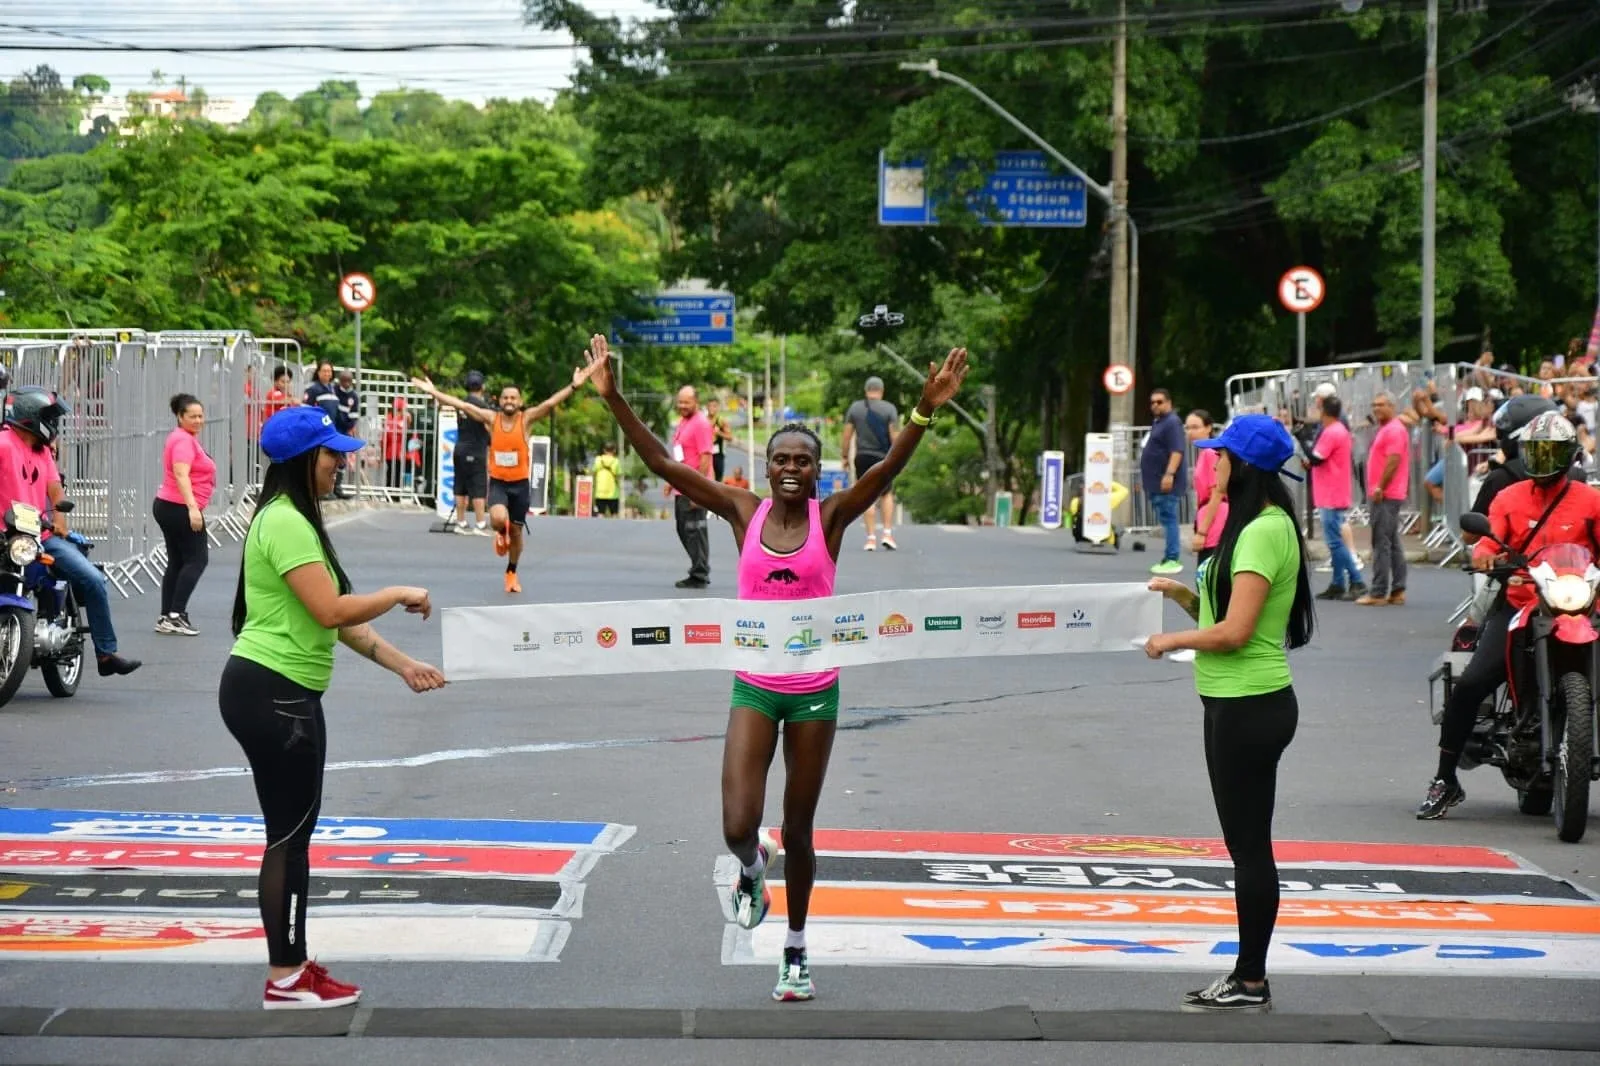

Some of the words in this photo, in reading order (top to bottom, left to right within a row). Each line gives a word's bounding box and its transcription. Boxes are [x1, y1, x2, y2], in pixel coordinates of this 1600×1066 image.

[1016, 178, 1083, 191] Esportes
[1008, 193, 1070, 205] Stadium
[1018, 208, 1083, 221] Deportes
[736, 619, 765, 630] CAIXA
[835, 613, 865, 624] CAIXA
[928, 618, 958, 626] Unimed
[903, 934, 1547, 959] CAIXA
